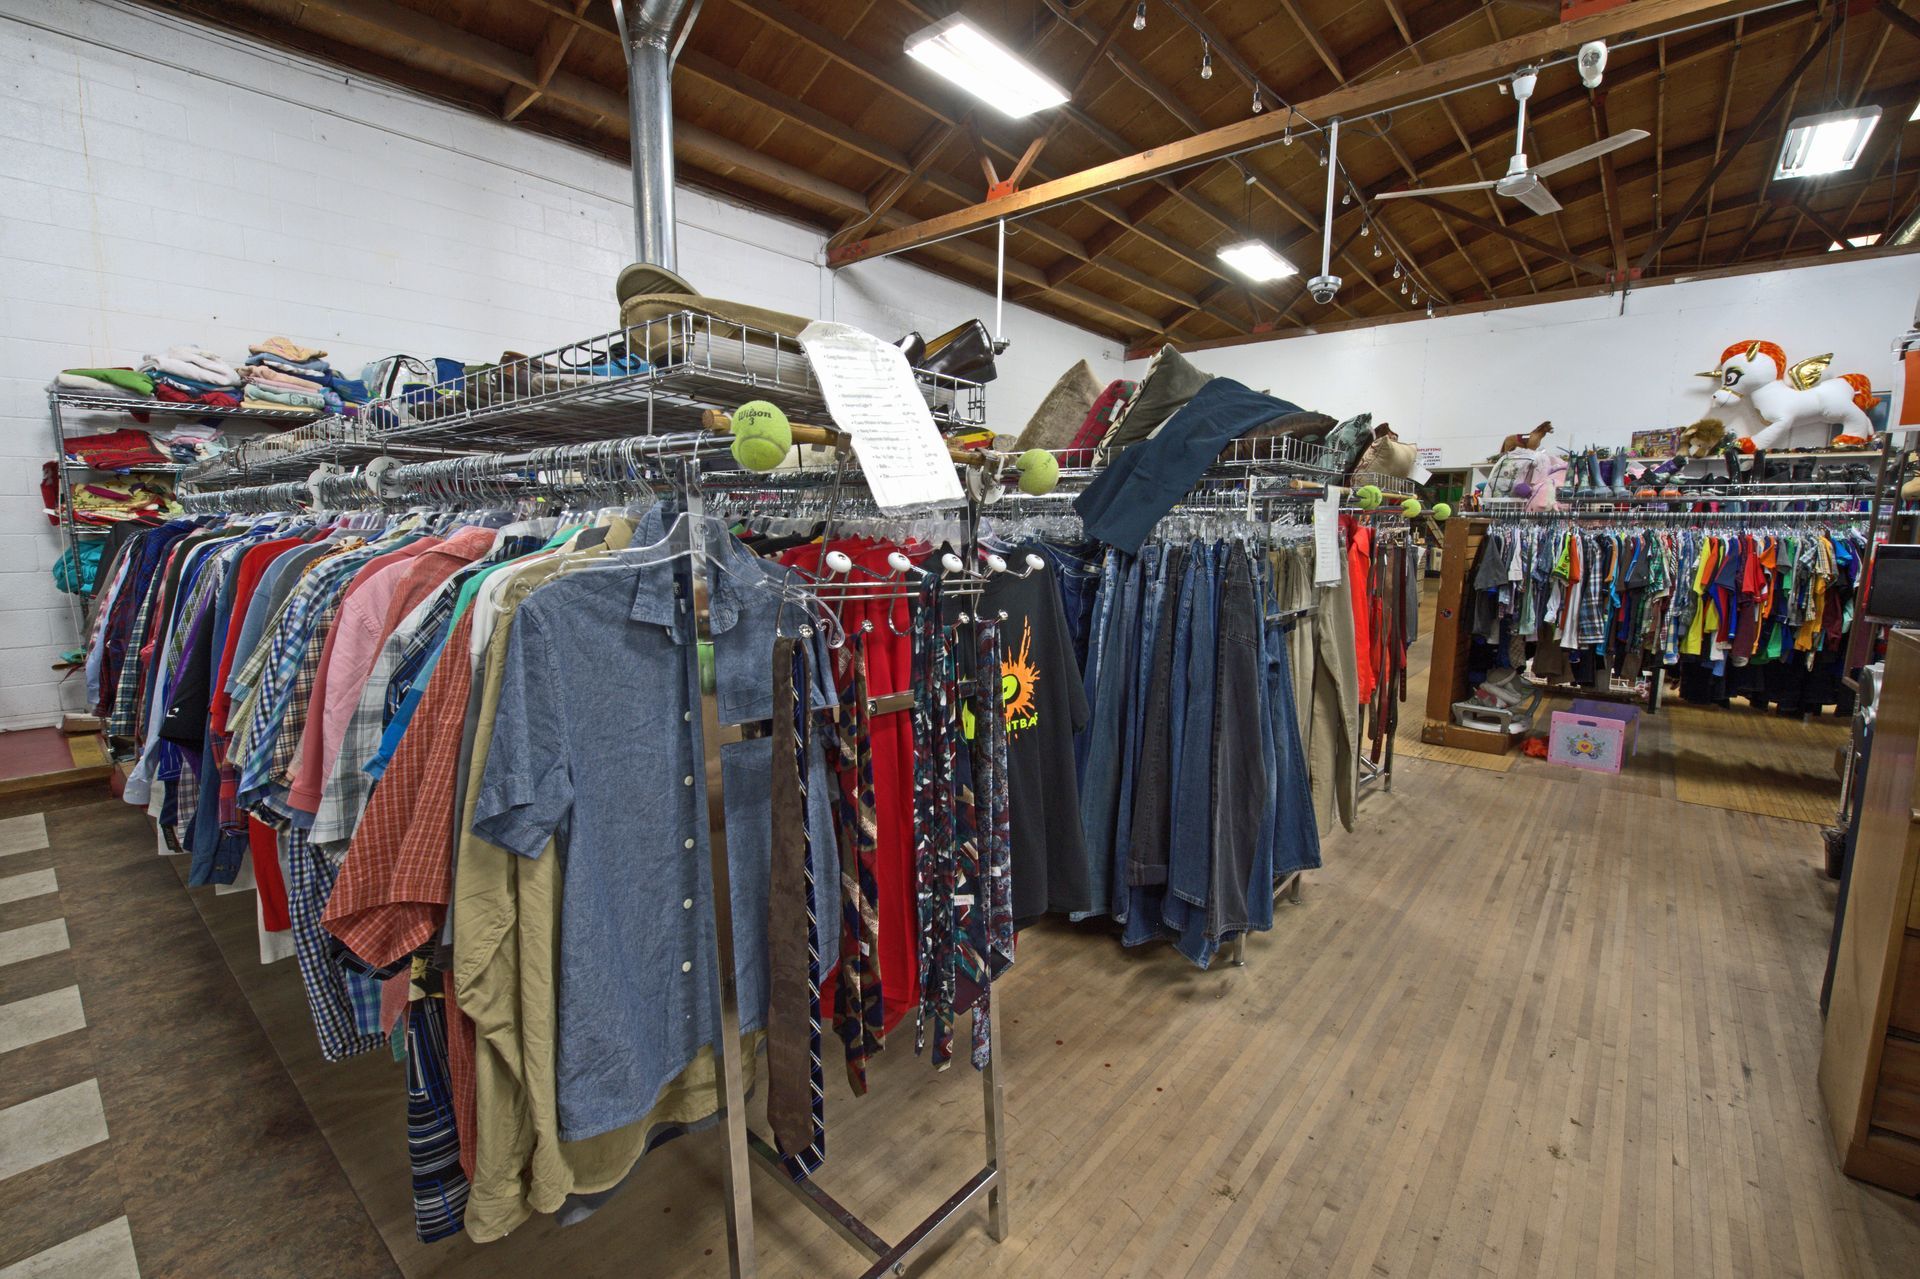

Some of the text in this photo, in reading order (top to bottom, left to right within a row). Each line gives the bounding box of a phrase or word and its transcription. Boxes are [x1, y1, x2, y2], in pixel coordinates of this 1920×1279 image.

[738, 406, 772, 421] Wilson
[748, 417, 755, 426] 3
[1006, 712, 1039, 733] NTBA
